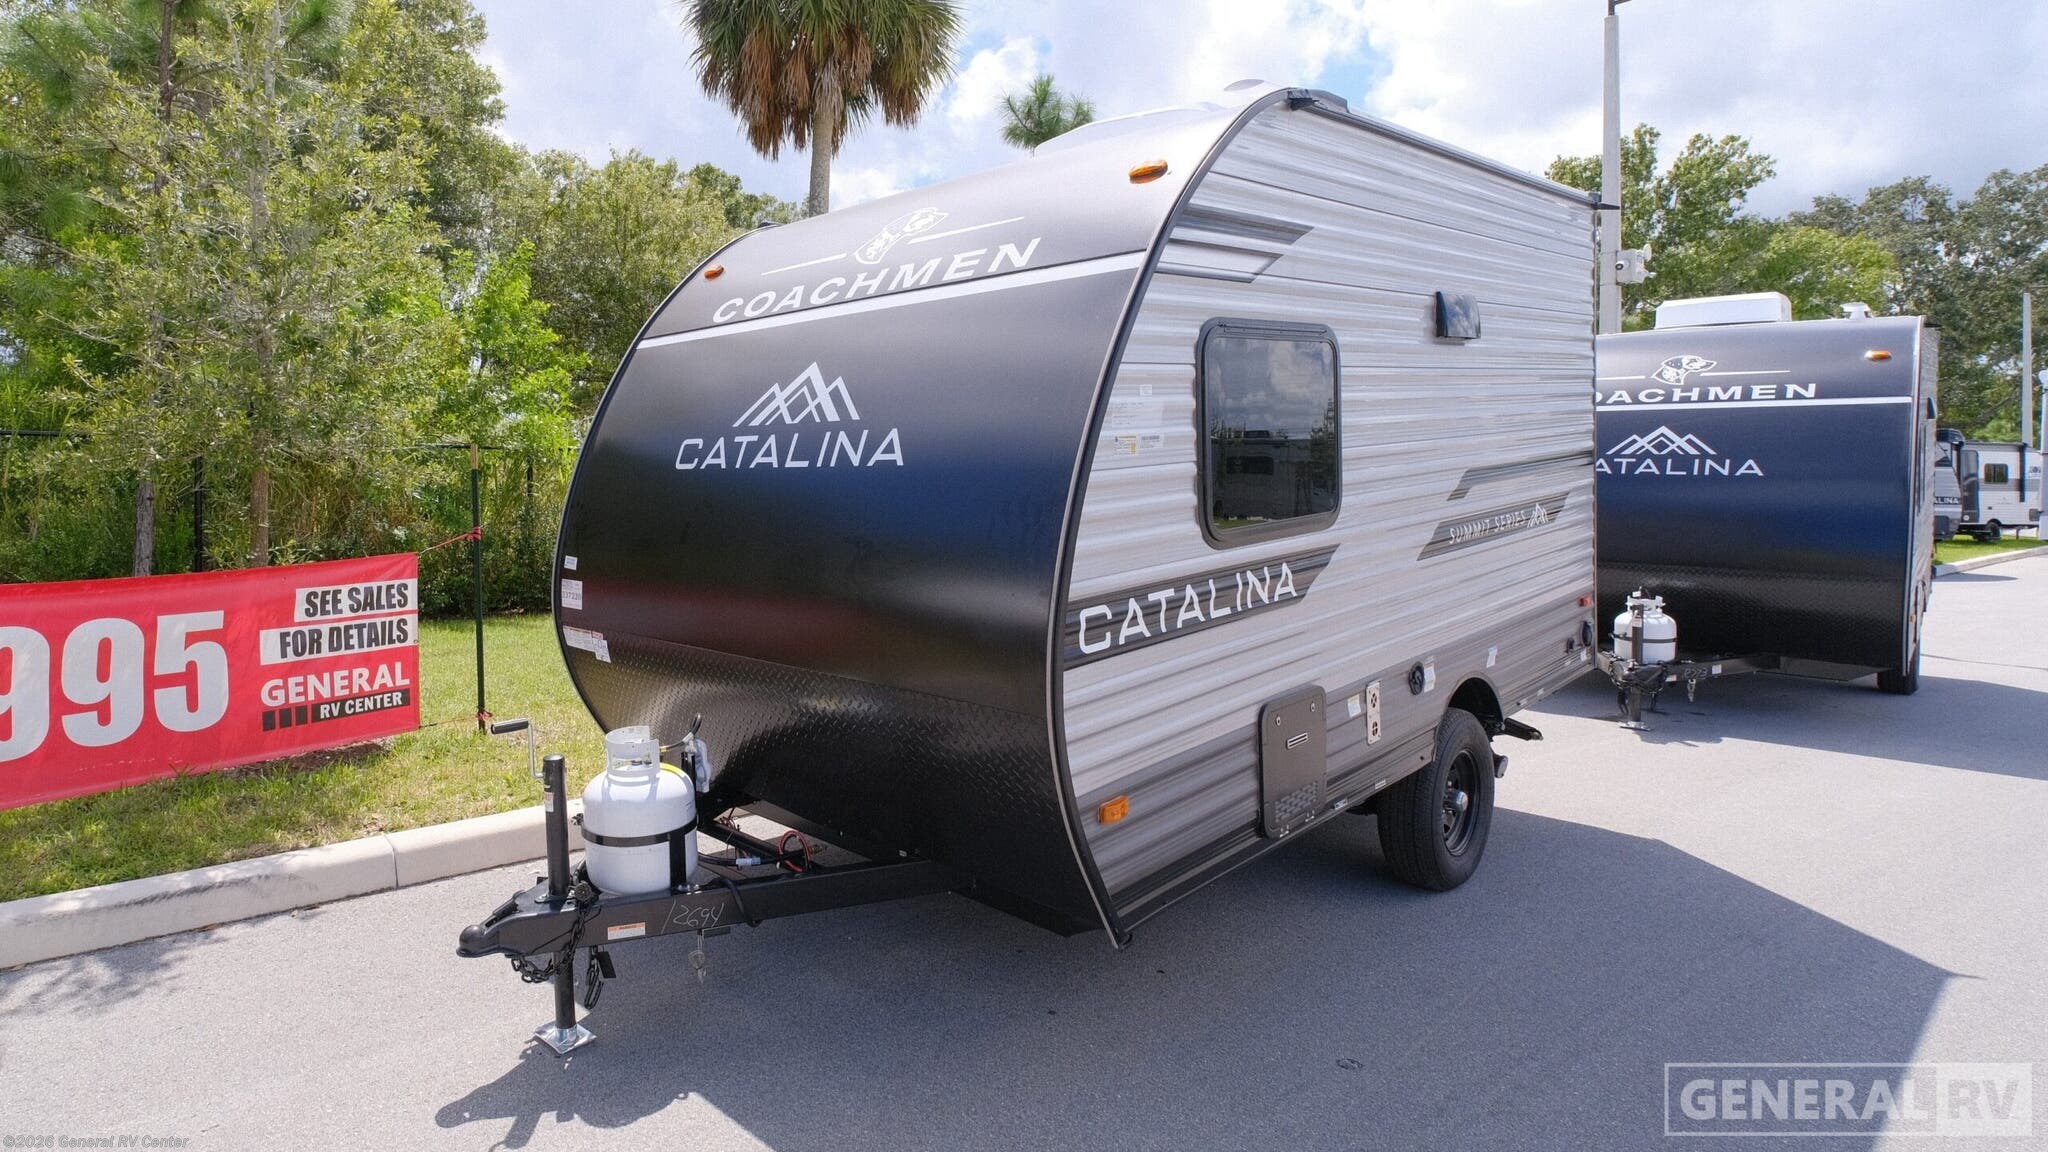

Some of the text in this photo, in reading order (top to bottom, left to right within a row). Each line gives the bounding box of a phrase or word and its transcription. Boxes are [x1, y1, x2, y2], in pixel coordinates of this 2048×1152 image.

[713, 236, 1042, 324] COACHMEN
[675, 427, 905, 471] CATALINA
[1448, 510, 1527, 545] SUMMIT SERIES
[304, 582, 408, 618] SEE SALES
[1078, 561, 1298, 655] CATALINA
[280, 618, 408, 659] FOR DETAILS
[260, 661, 410, 707] GENERAL
[320, 691, 402, 719] RV CENTER
